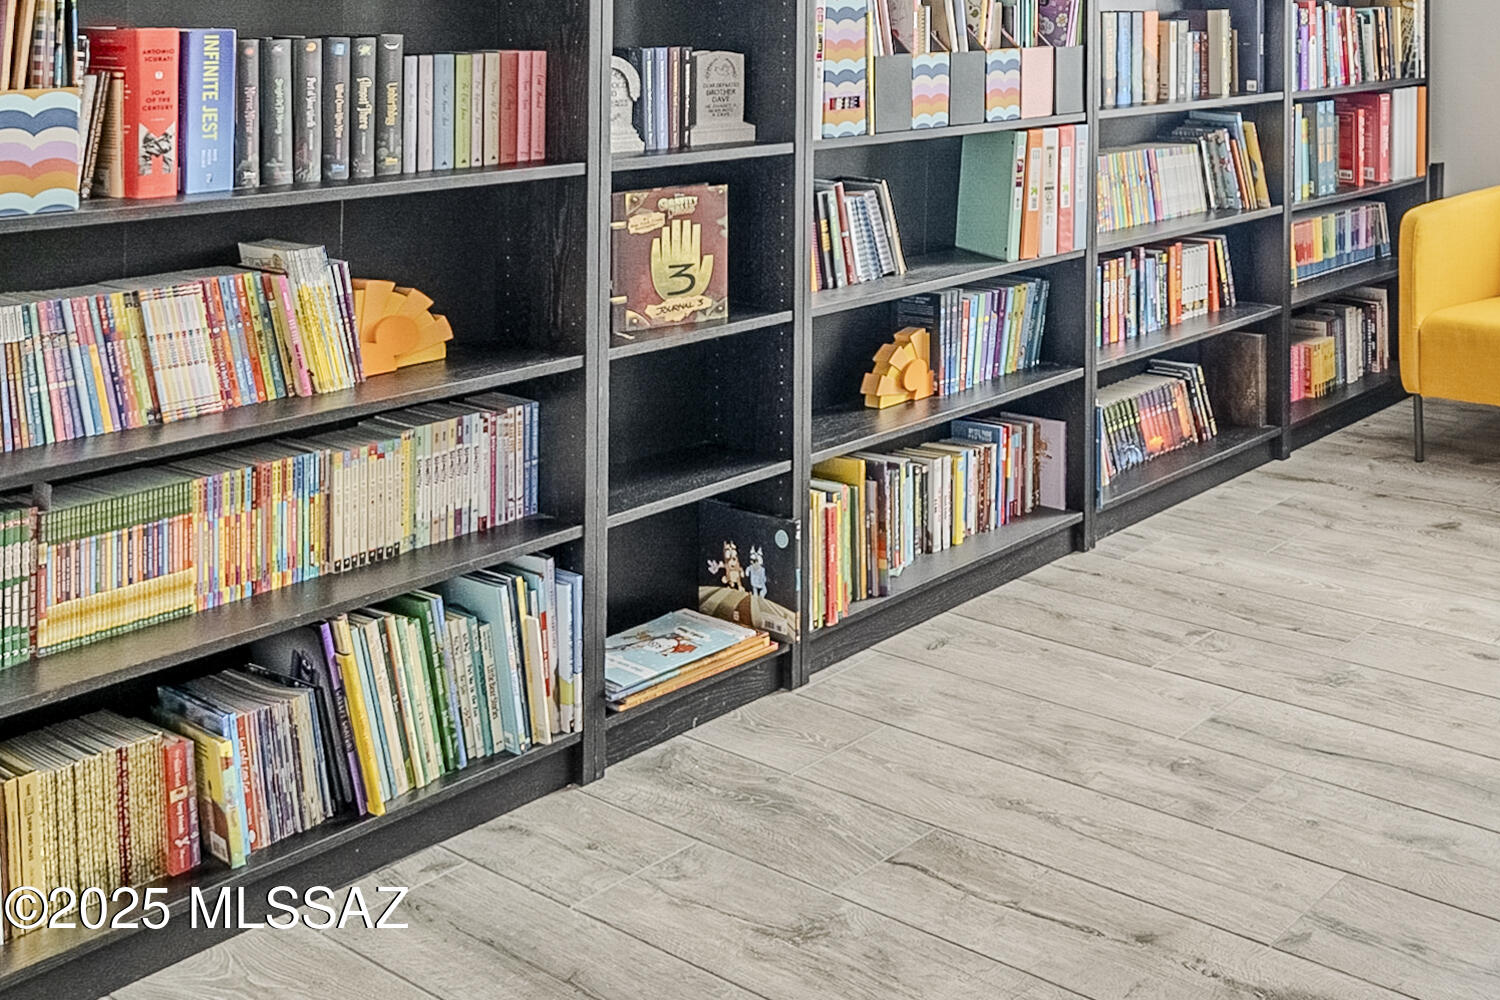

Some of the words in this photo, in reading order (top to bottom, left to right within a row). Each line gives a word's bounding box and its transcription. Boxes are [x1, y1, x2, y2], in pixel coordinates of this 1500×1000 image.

[202, 35, 219, 100] INFINITE
[202, 105, 218, 140] JEST
[667, 263, 696, 296] 3
[656, 302, 694, 316] JOURNAL
[697, 299, 704, 308] 3
